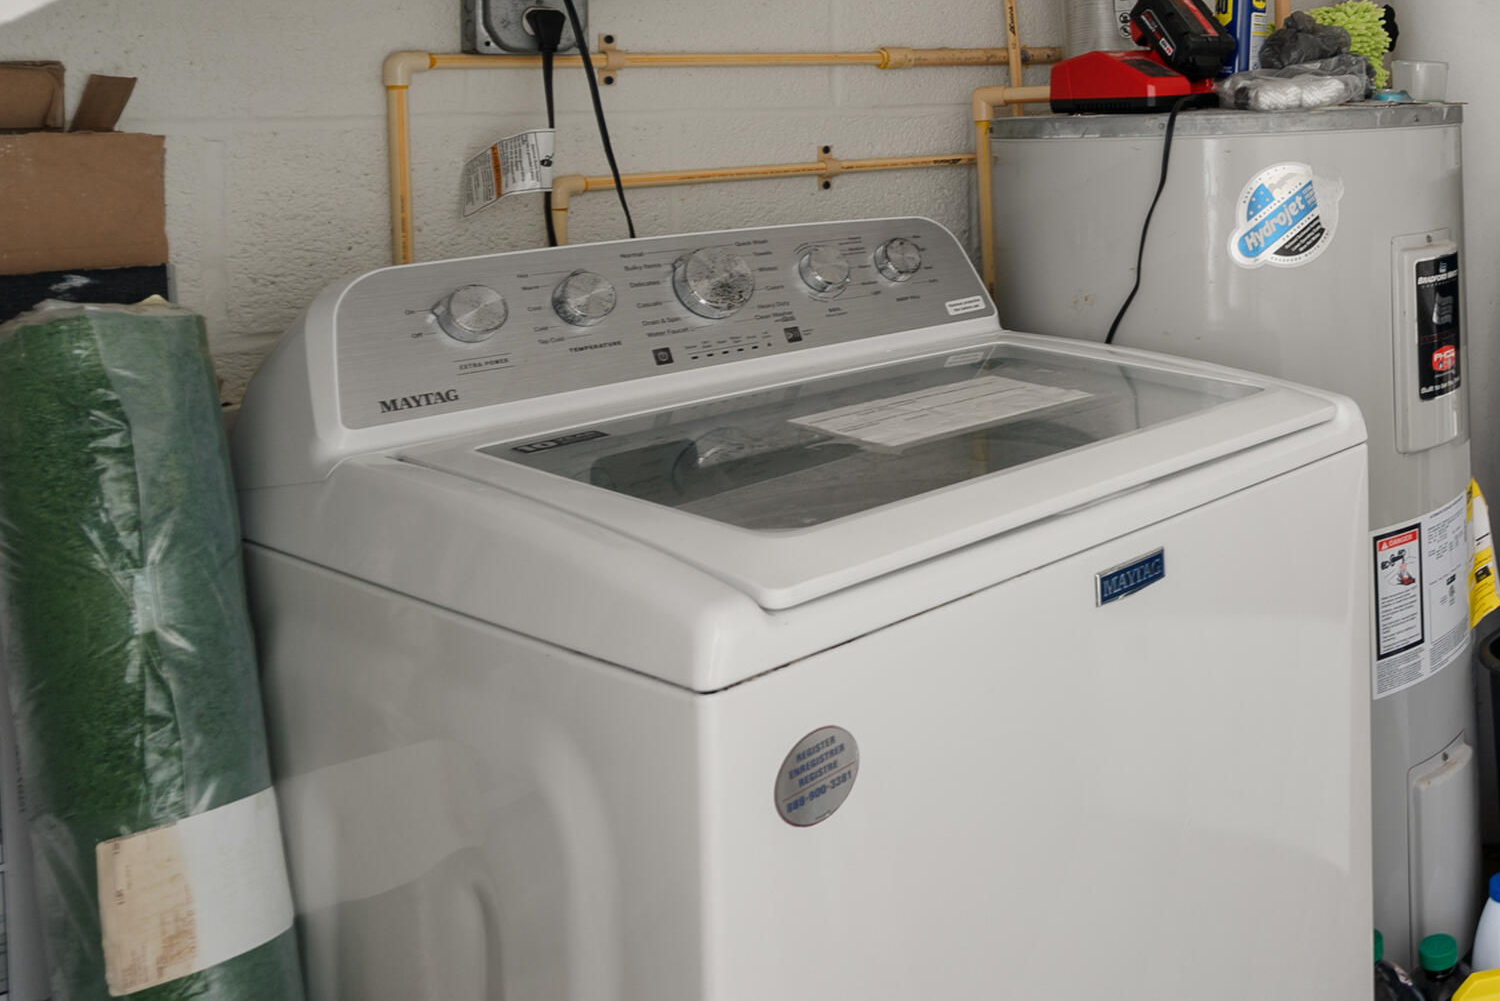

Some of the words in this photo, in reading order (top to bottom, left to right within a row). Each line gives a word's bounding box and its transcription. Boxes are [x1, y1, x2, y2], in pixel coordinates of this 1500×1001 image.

[1244, 194, 1306, 252] Hydrojet
[568, 340, 623, 353] TEMPERATURE
[459, 361, 484, 371] EXTRA
[484, 357, 509, 367] POWER
[379, 388, 460, 414] MAYTAG
[1103, 558, 1162, 597] MAYTAG
[796, 735, 836, 763] REGISTER
